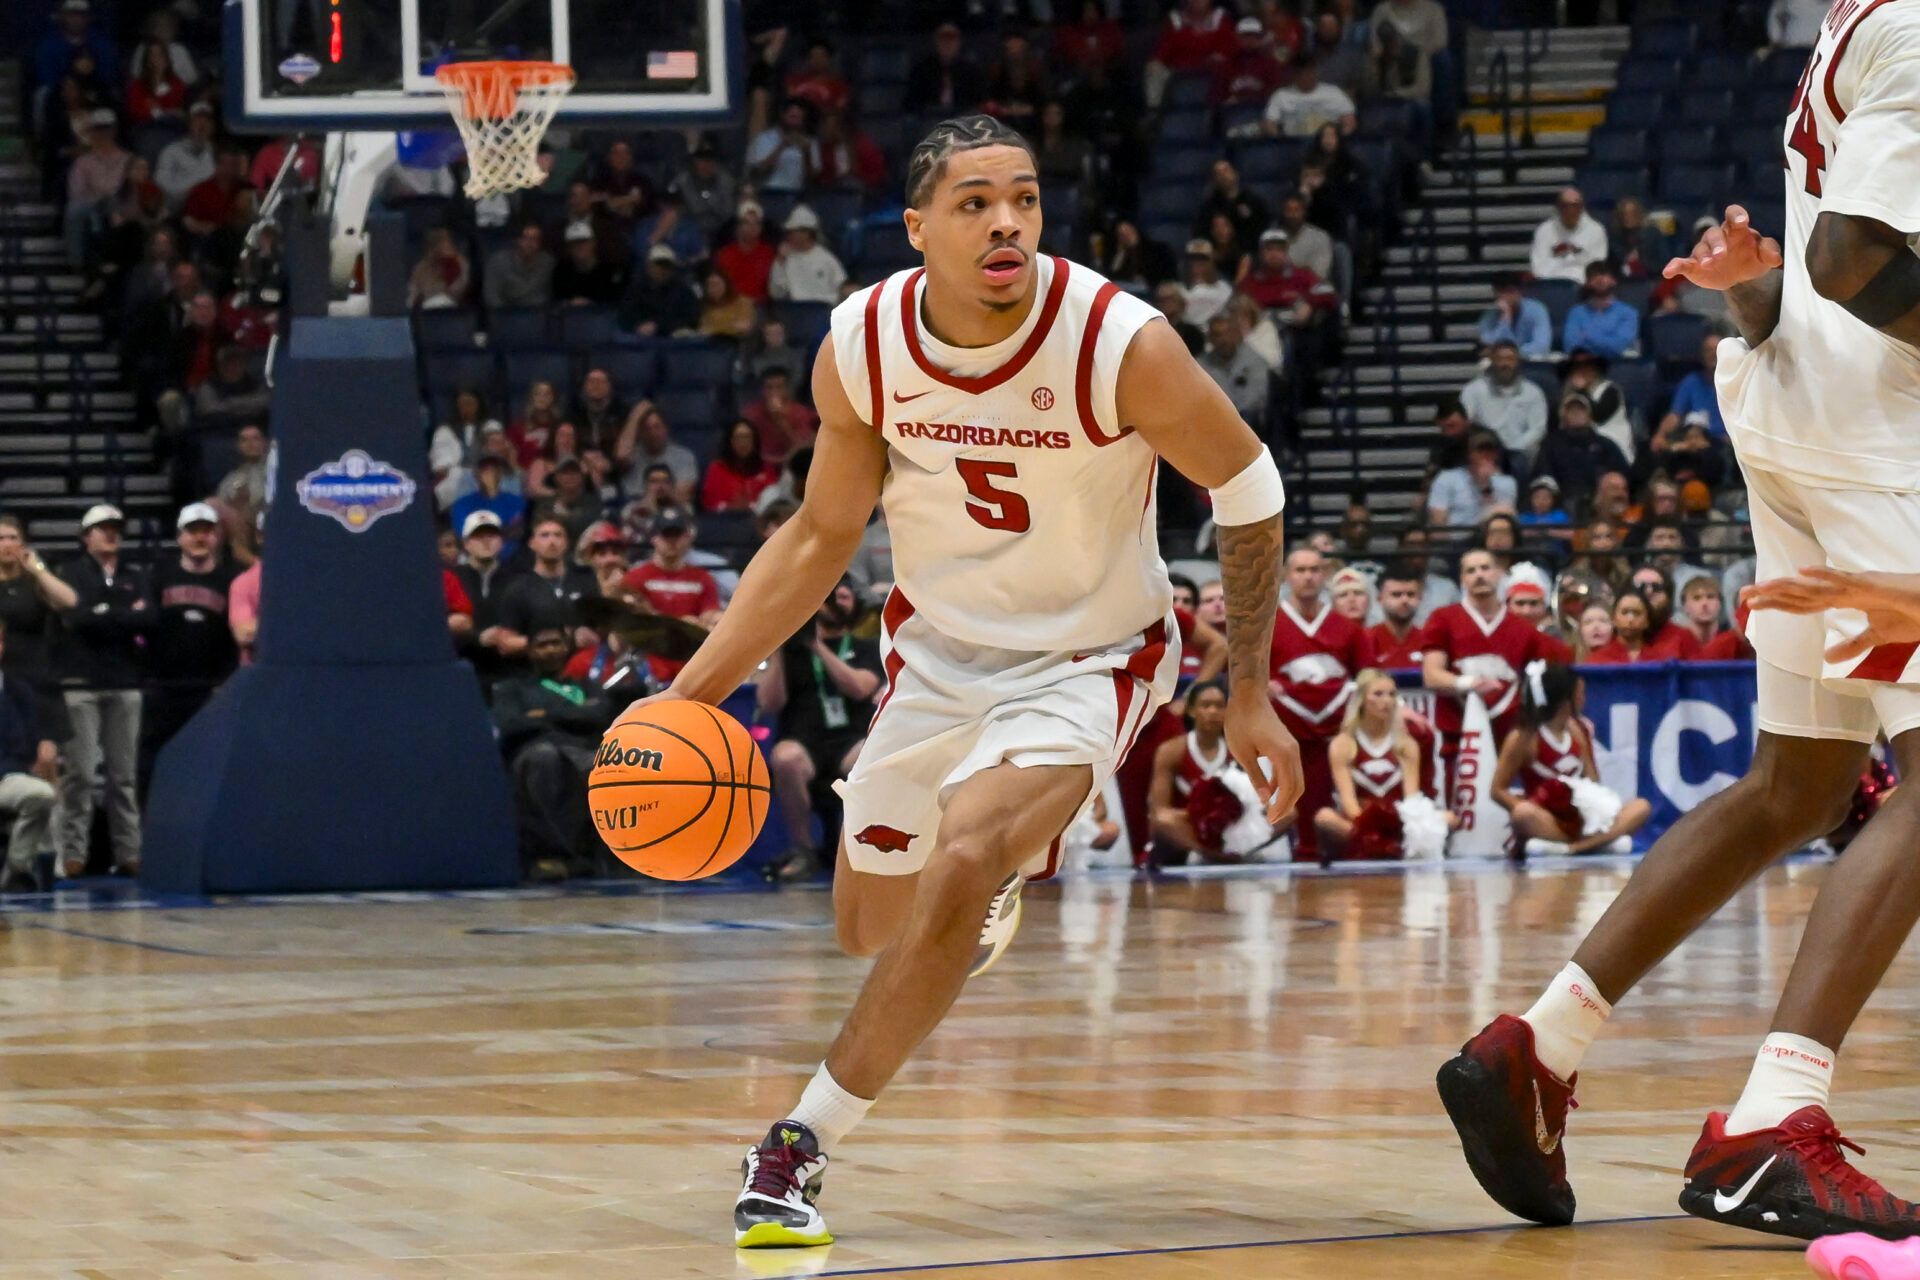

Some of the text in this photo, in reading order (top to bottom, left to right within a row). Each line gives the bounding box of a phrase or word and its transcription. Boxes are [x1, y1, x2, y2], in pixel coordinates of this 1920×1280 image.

[1032, 388, 1054, 410] SEC
[894, 422, 1071, 449] RAZORBACKS
[955, 457, 1031, 534] 5
[639, 800, 660, 812] NXT
[1761, 1044, 1830, 1070] Supreme
